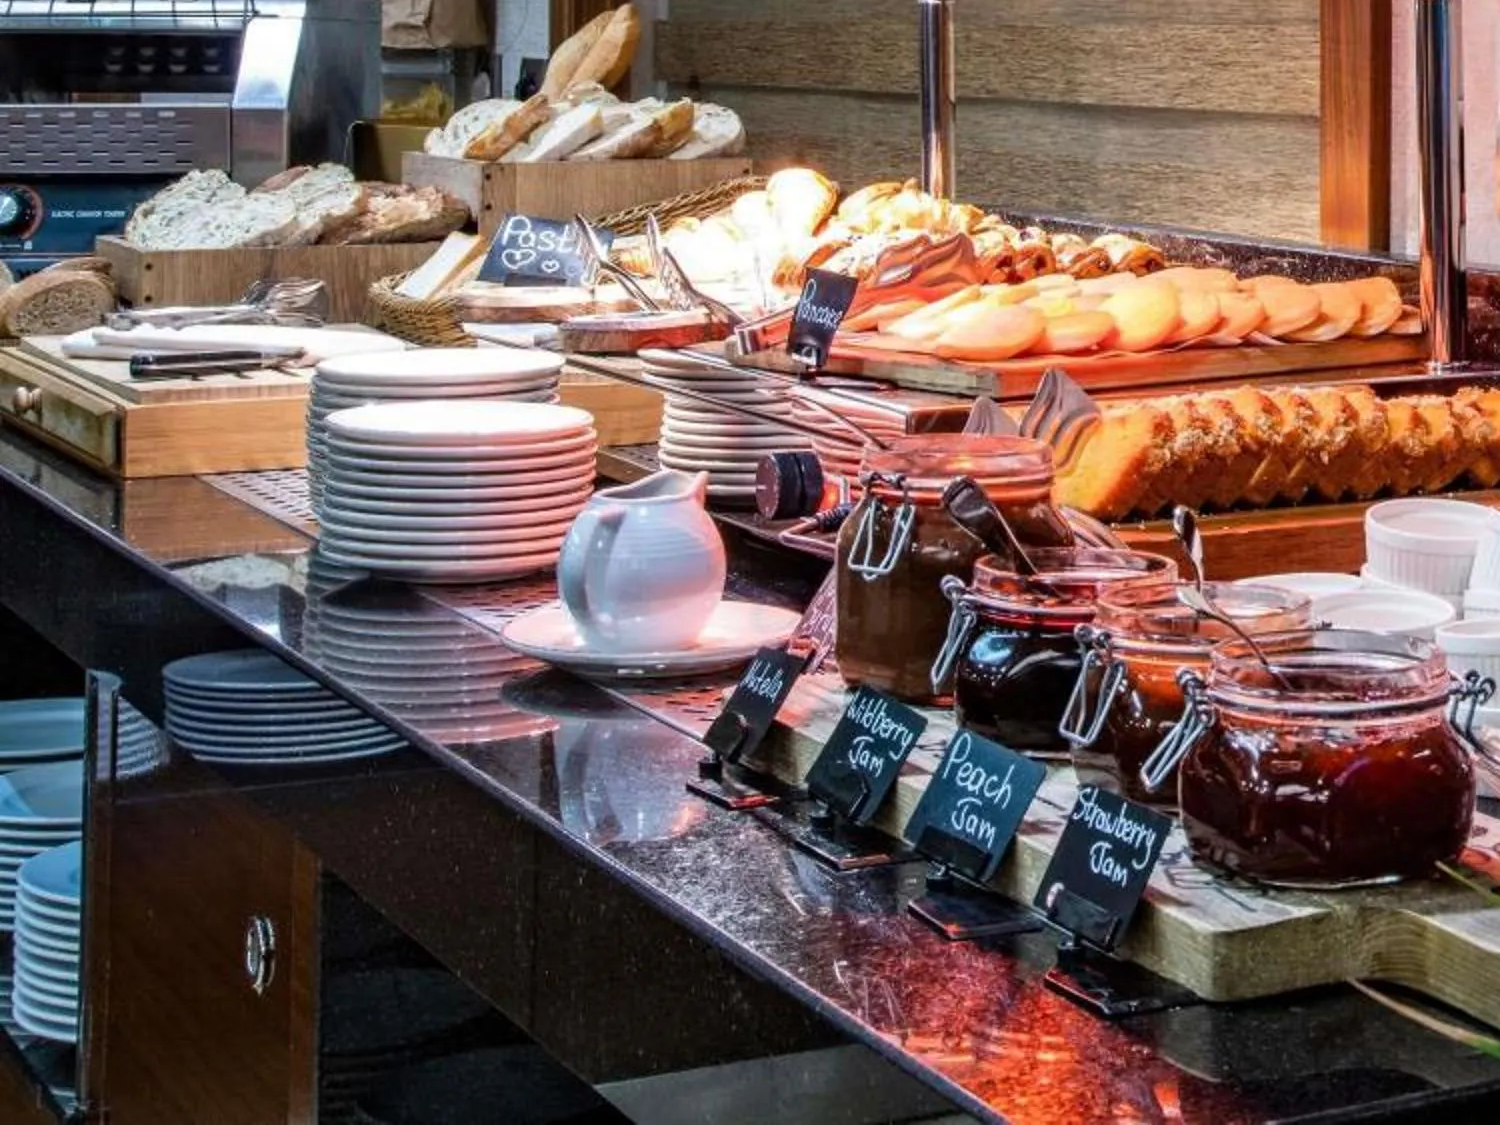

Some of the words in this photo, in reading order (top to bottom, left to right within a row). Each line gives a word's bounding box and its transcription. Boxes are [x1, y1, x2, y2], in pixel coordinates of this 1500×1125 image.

[848, 736, 884, 777] Jam
[944, 732, 1014, 809] Peach
[952, 797, 996, 848] Jam
[1072, 787, 1156, 869] Strawberry
[1090, 841, 1128, 886] Jam
